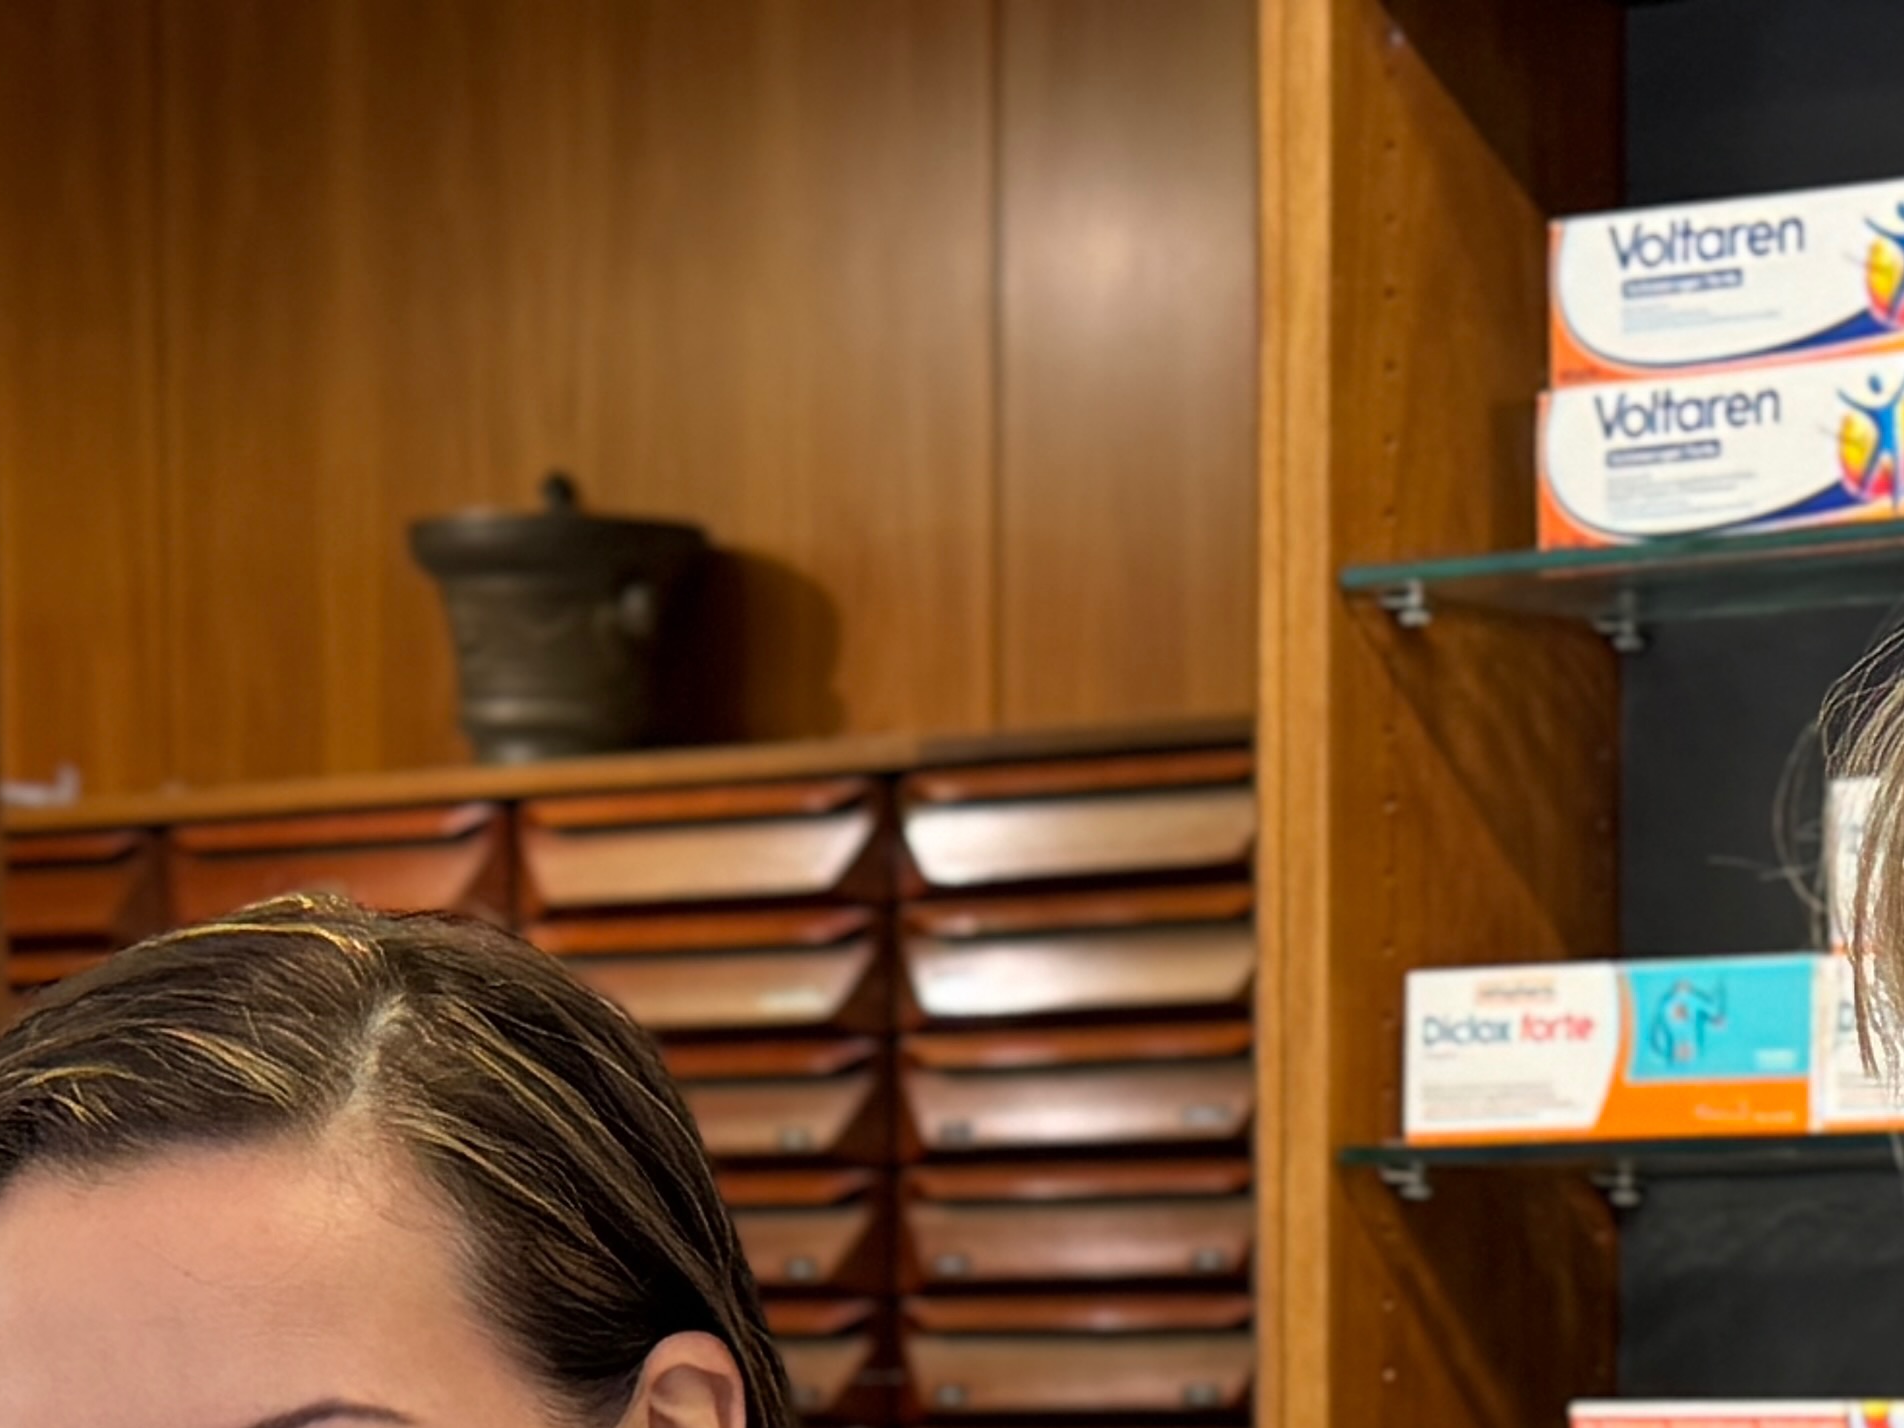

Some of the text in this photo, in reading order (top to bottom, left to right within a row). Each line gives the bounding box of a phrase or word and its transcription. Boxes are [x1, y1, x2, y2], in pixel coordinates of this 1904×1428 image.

[1608, 216, 1804, 270] Voltaren
[1594, 388, 1780, 440] Voltaren
[1520, 1010, 1595, 1042] forte
